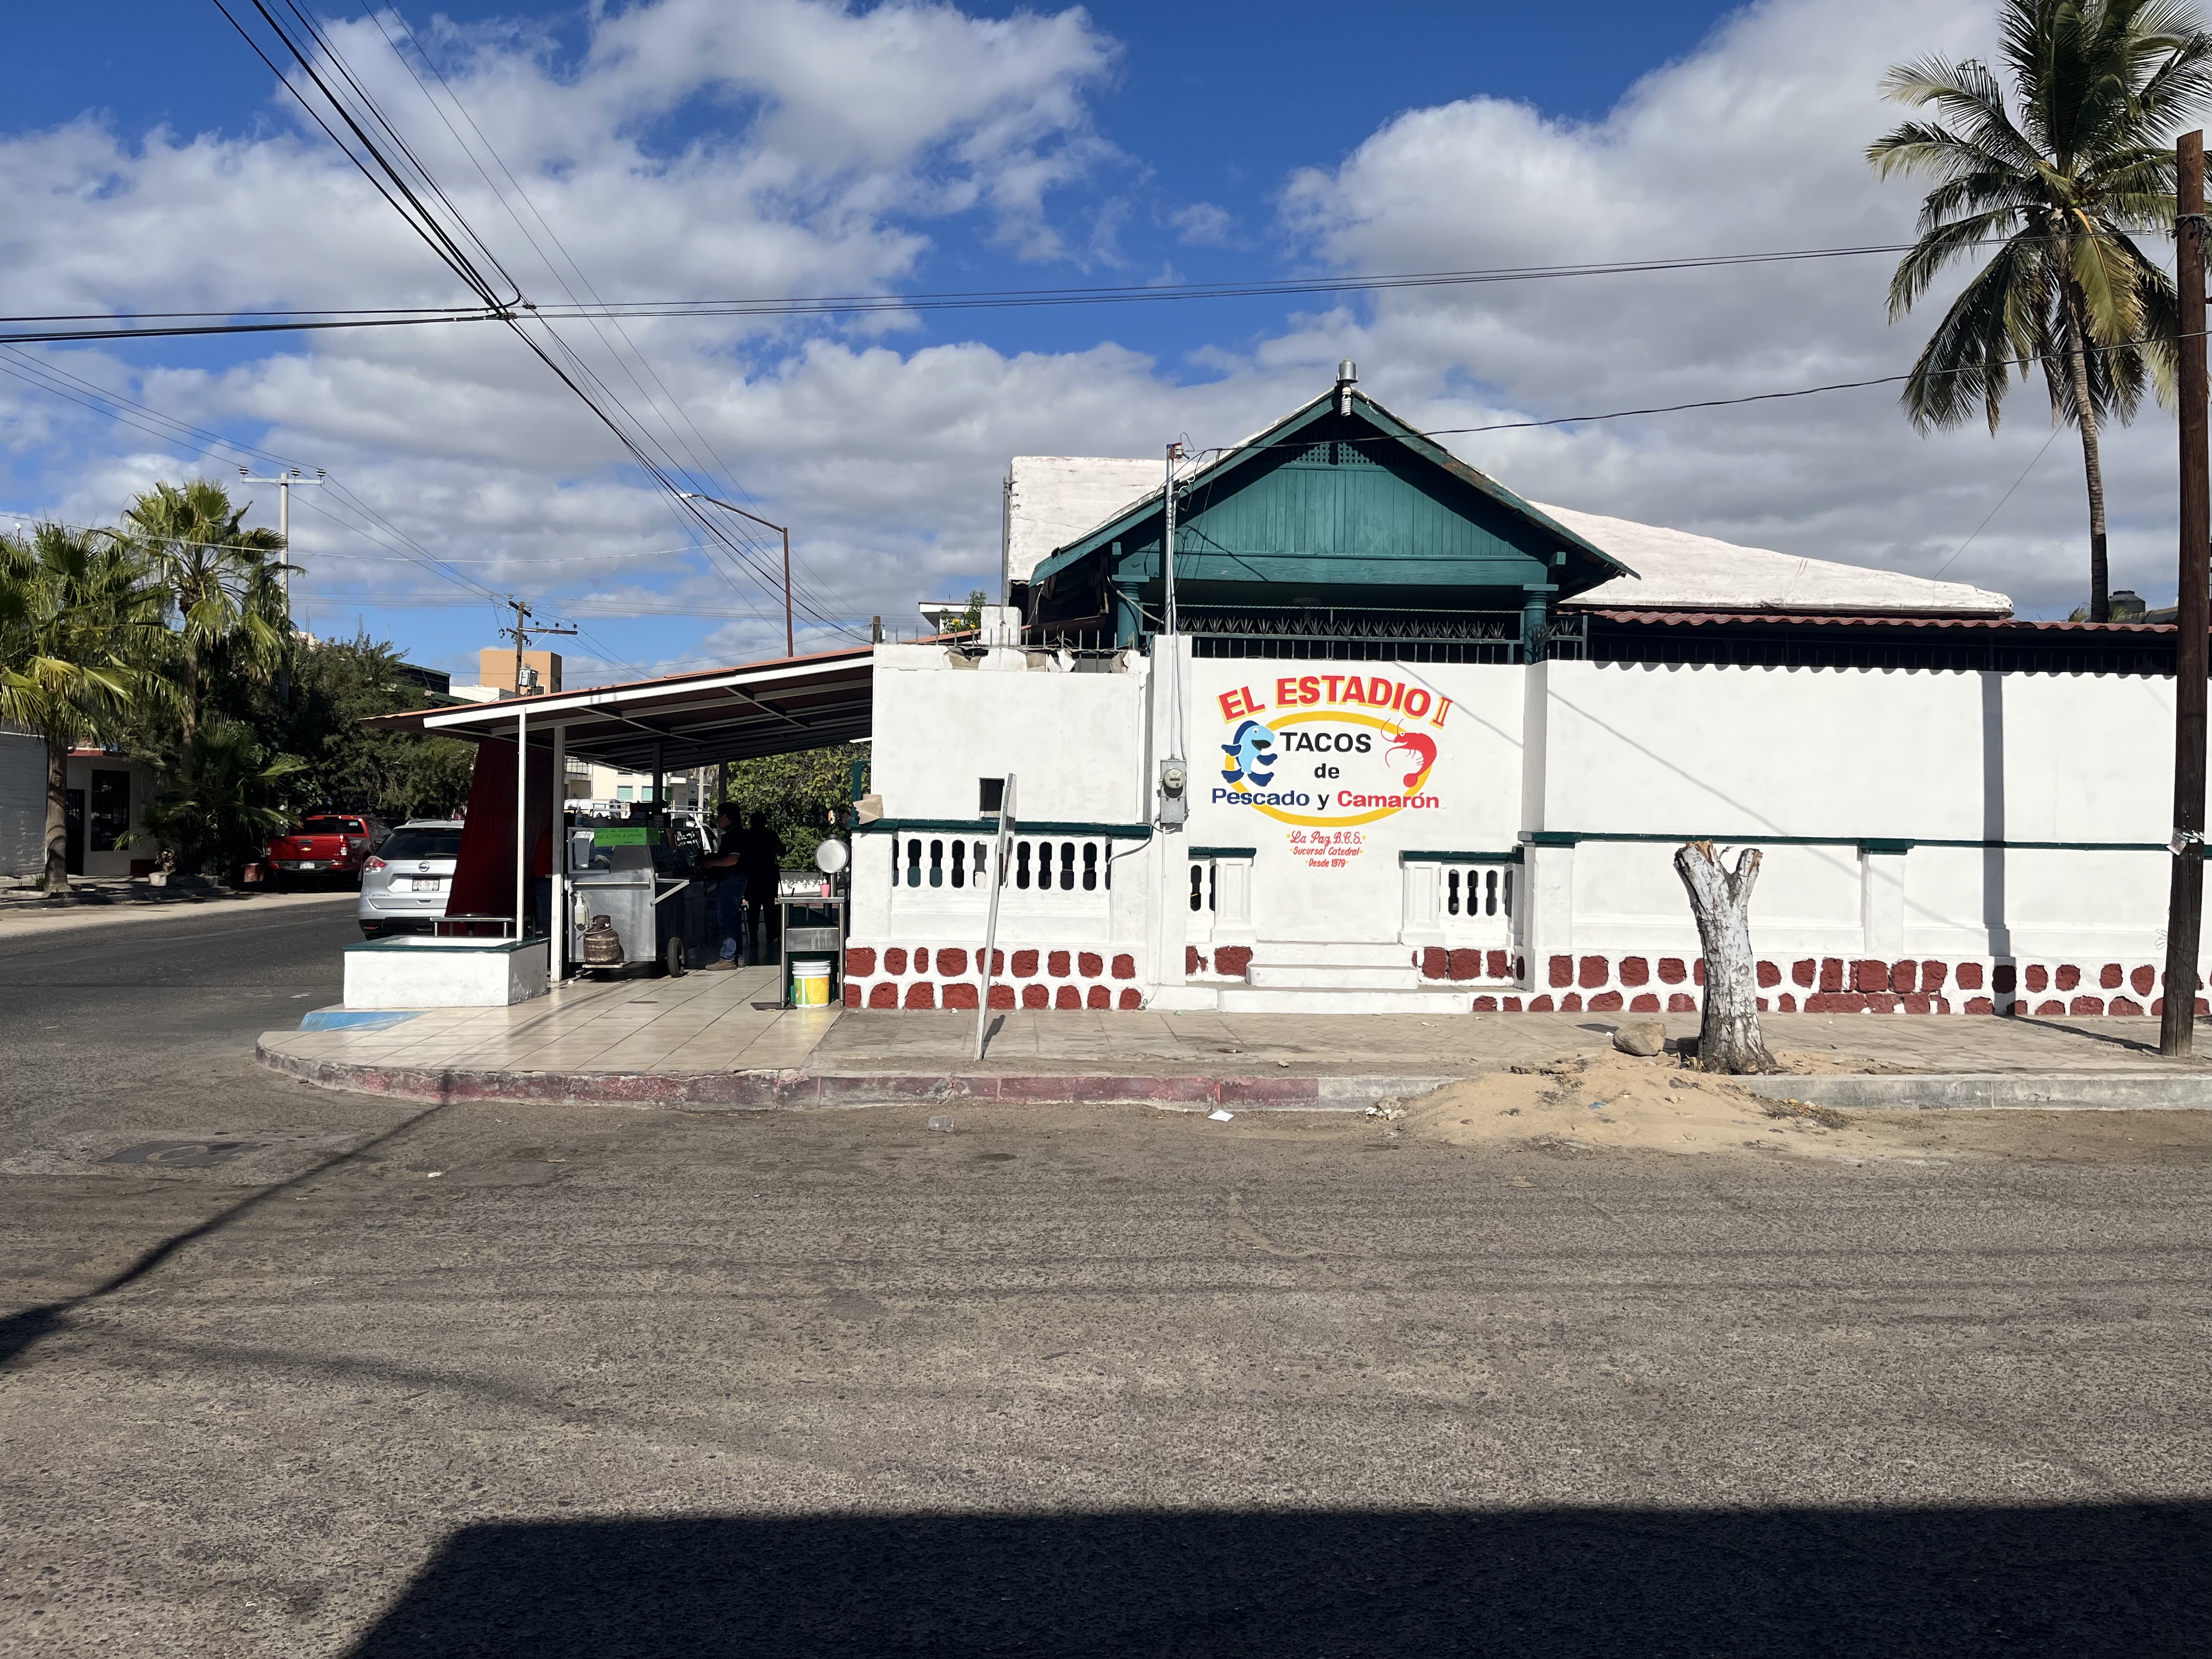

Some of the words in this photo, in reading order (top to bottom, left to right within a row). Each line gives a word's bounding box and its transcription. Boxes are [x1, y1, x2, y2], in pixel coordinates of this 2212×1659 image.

[1216, 686, 1266, 724] EL
[1276, 675, 1431, 720] ESTADIO
[1279, 732, 1372, 753] TACOS
[1314, 763, 1340, 779] de
[1212, 788, 1310, 806] Pescado
[1317, 794, 1330, 810] y
[1337, 790, 1440, 809] Camarón
[1290, 831, 1307, 844] La
[1293, 846, 1326, 855] Sucursal
[1328, 847, 1360, 856] Catedral
[1308, 858, 1329, 867] Desde
[1331, 859, 1346, 867] 1979
